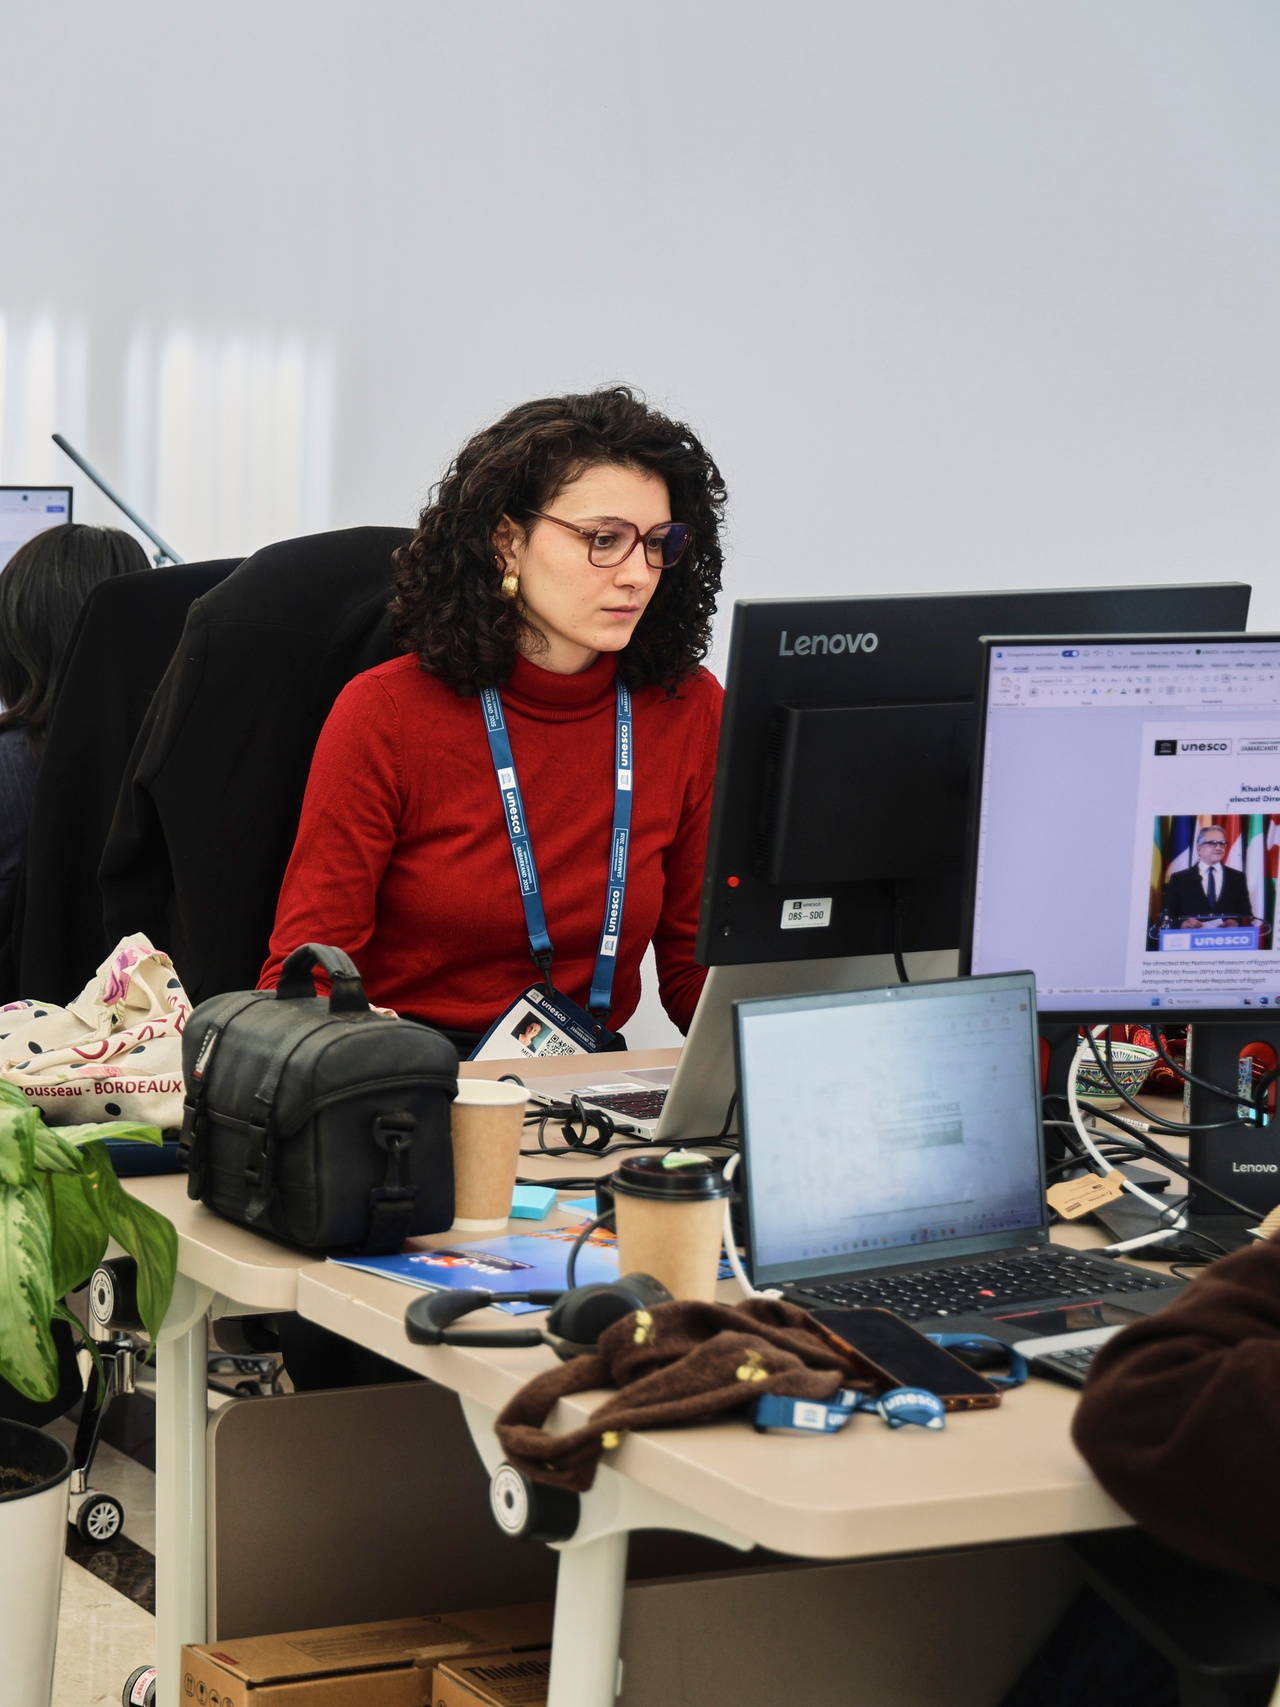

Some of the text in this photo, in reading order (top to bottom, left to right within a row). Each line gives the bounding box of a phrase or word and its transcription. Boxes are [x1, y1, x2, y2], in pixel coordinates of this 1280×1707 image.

[779, 630, 879, 656] Lenovo
[1181, 742, 1228, 751] unesco
[506, 791, 521, 834] unesco
[516, 846, 527, 878] SAMARKAND
[608, 890, 620, 932] unesco
[1194, 936, 1250, 946] unesco
[541, 1000, 567, 1022] unesco
[94, 1080, 183, 1095] BORDEAUX
[1232, 1162, 1278, 1173] Lenovo
